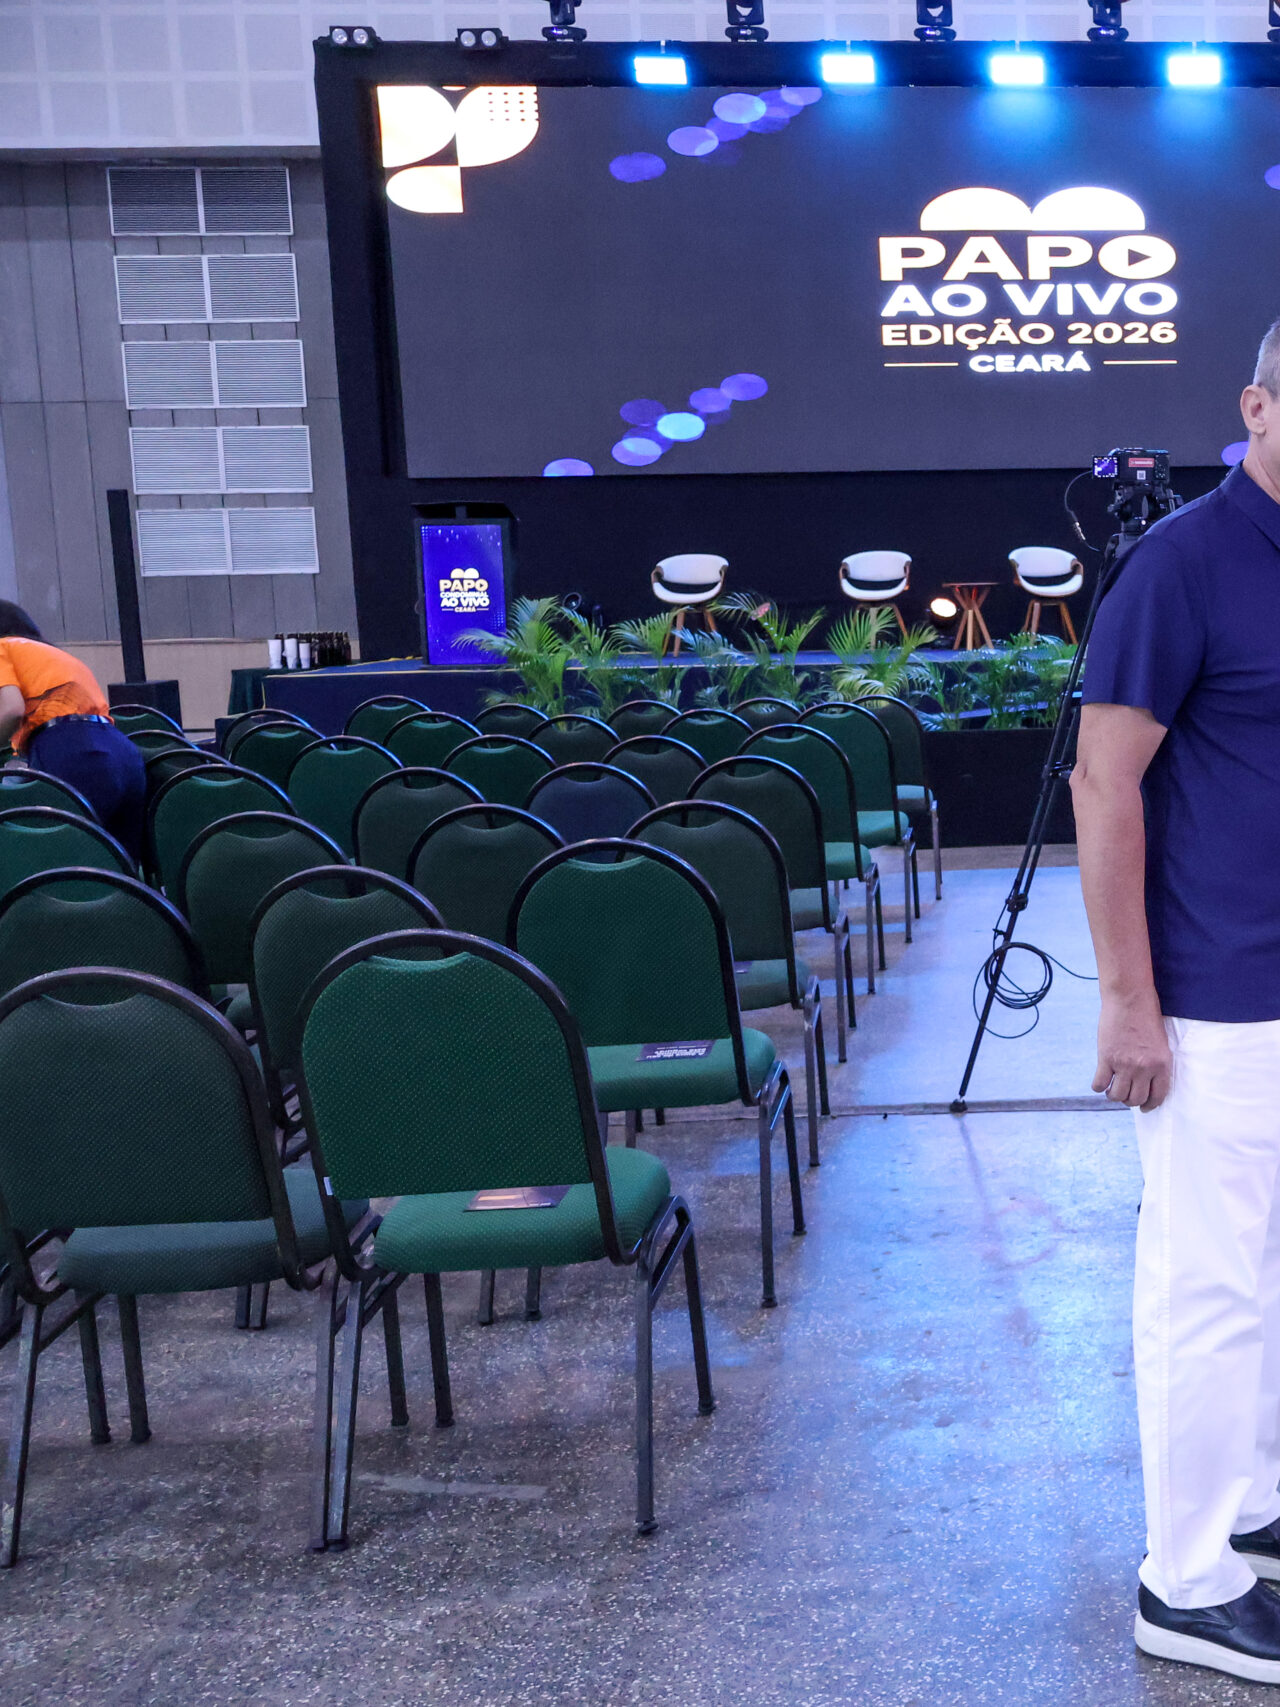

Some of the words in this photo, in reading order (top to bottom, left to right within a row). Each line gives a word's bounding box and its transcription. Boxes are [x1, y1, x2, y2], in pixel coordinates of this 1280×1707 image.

[879, 235, 1177, 281] PAPO
[880, 284, 987, 317] AO
[1003, 283, 1178, 316] VIVO
[881, 318, 1055, 350] EDIÇÃO
[1067, 322, 1177, 344] 2026
[969, 351, 1091, 373] CEARÁ
[439, 579, 488, 592] PAPO
[440, 598, 459, 607] AO
[460, 597, 490, 607] VIVO
